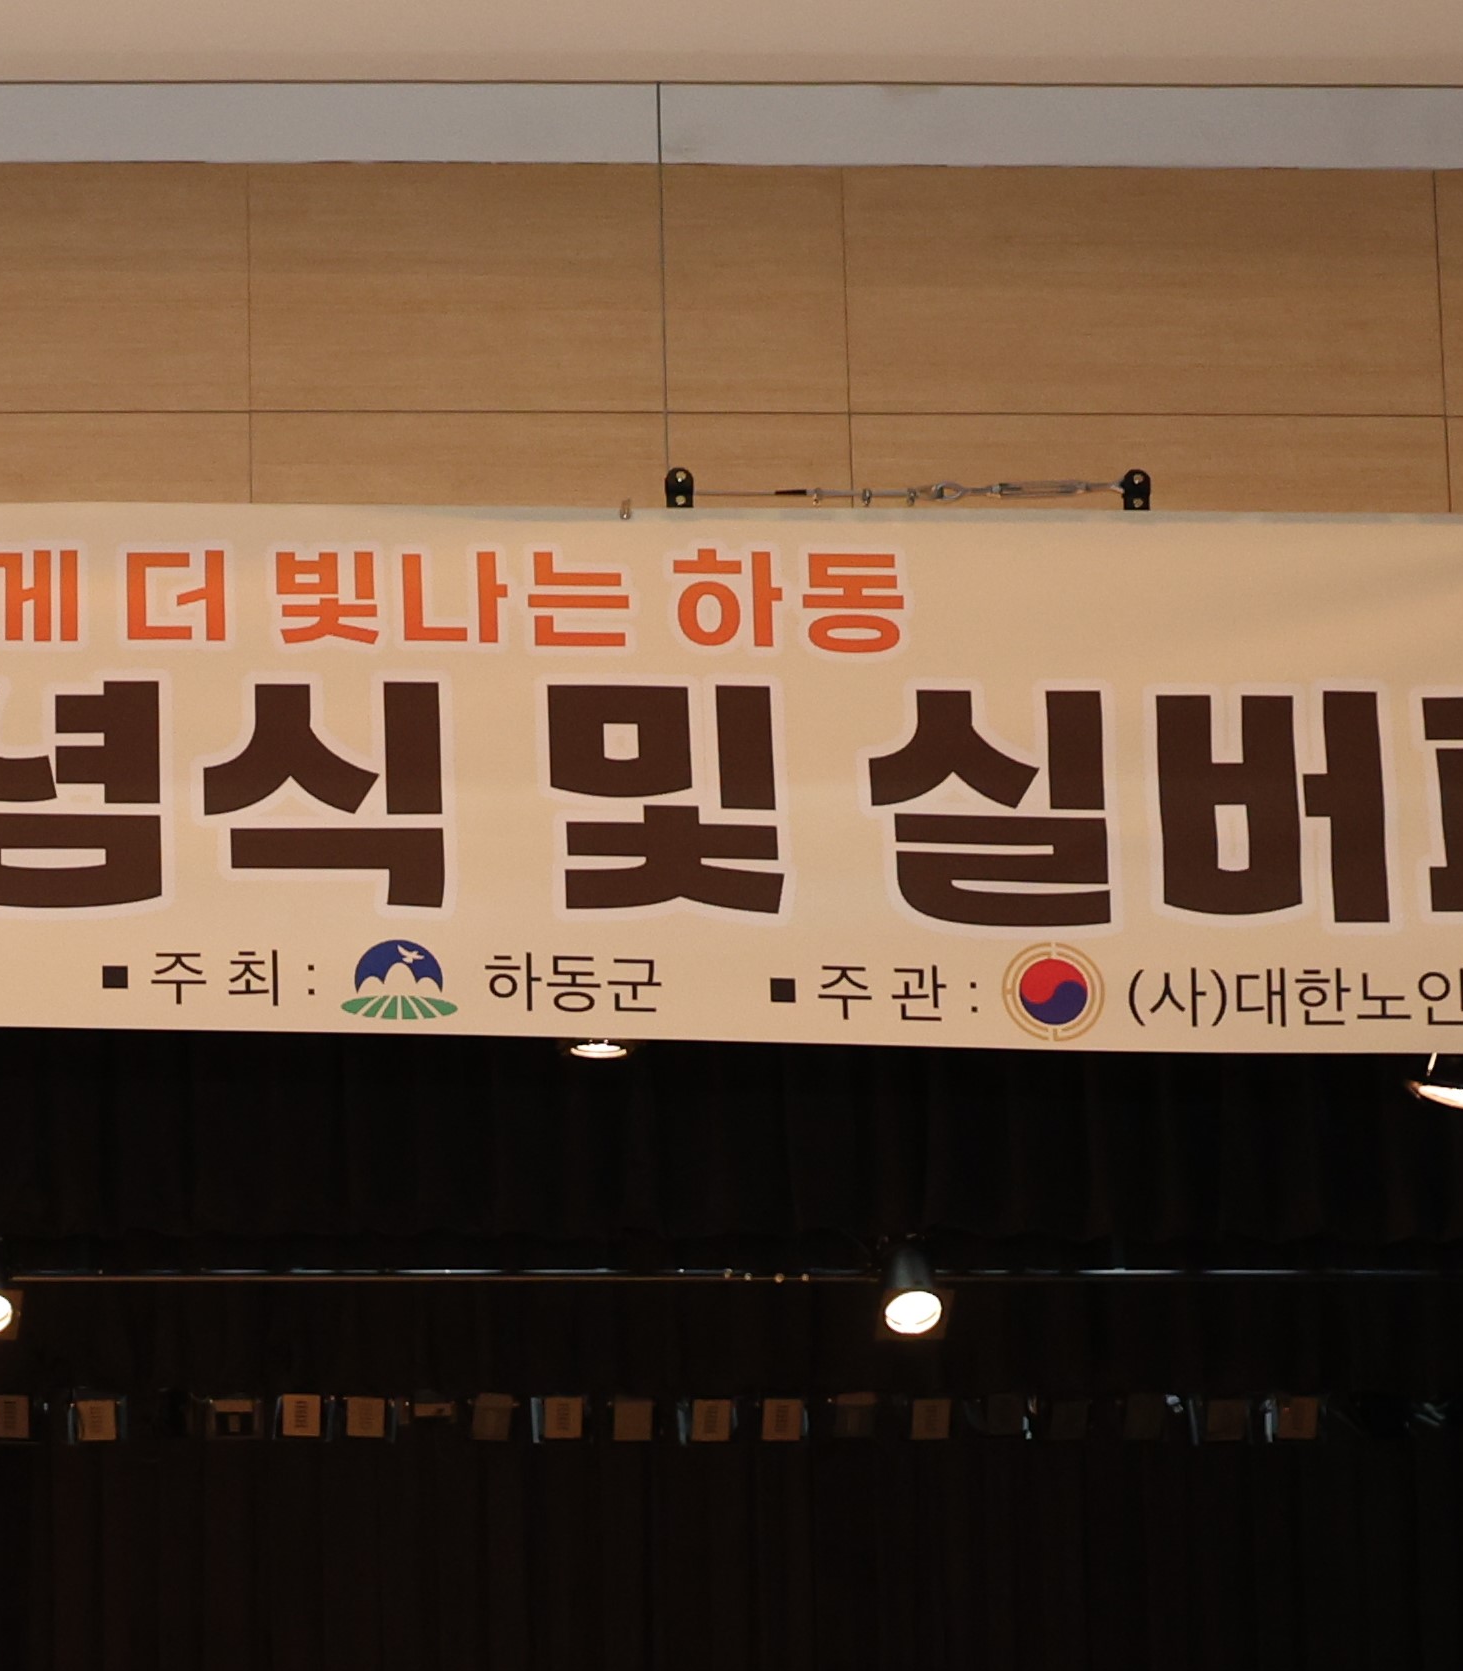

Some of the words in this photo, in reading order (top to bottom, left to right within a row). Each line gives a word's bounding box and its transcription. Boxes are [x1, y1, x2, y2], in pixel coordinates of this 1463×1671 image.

[128, 551, 225, 640] 더
[278, 552, 629, 646] 빛나는
[675, 549, 903, 652] 하동
[547, 685, 784, 914] 및
[485, 953, 661, 1012] 하동군
